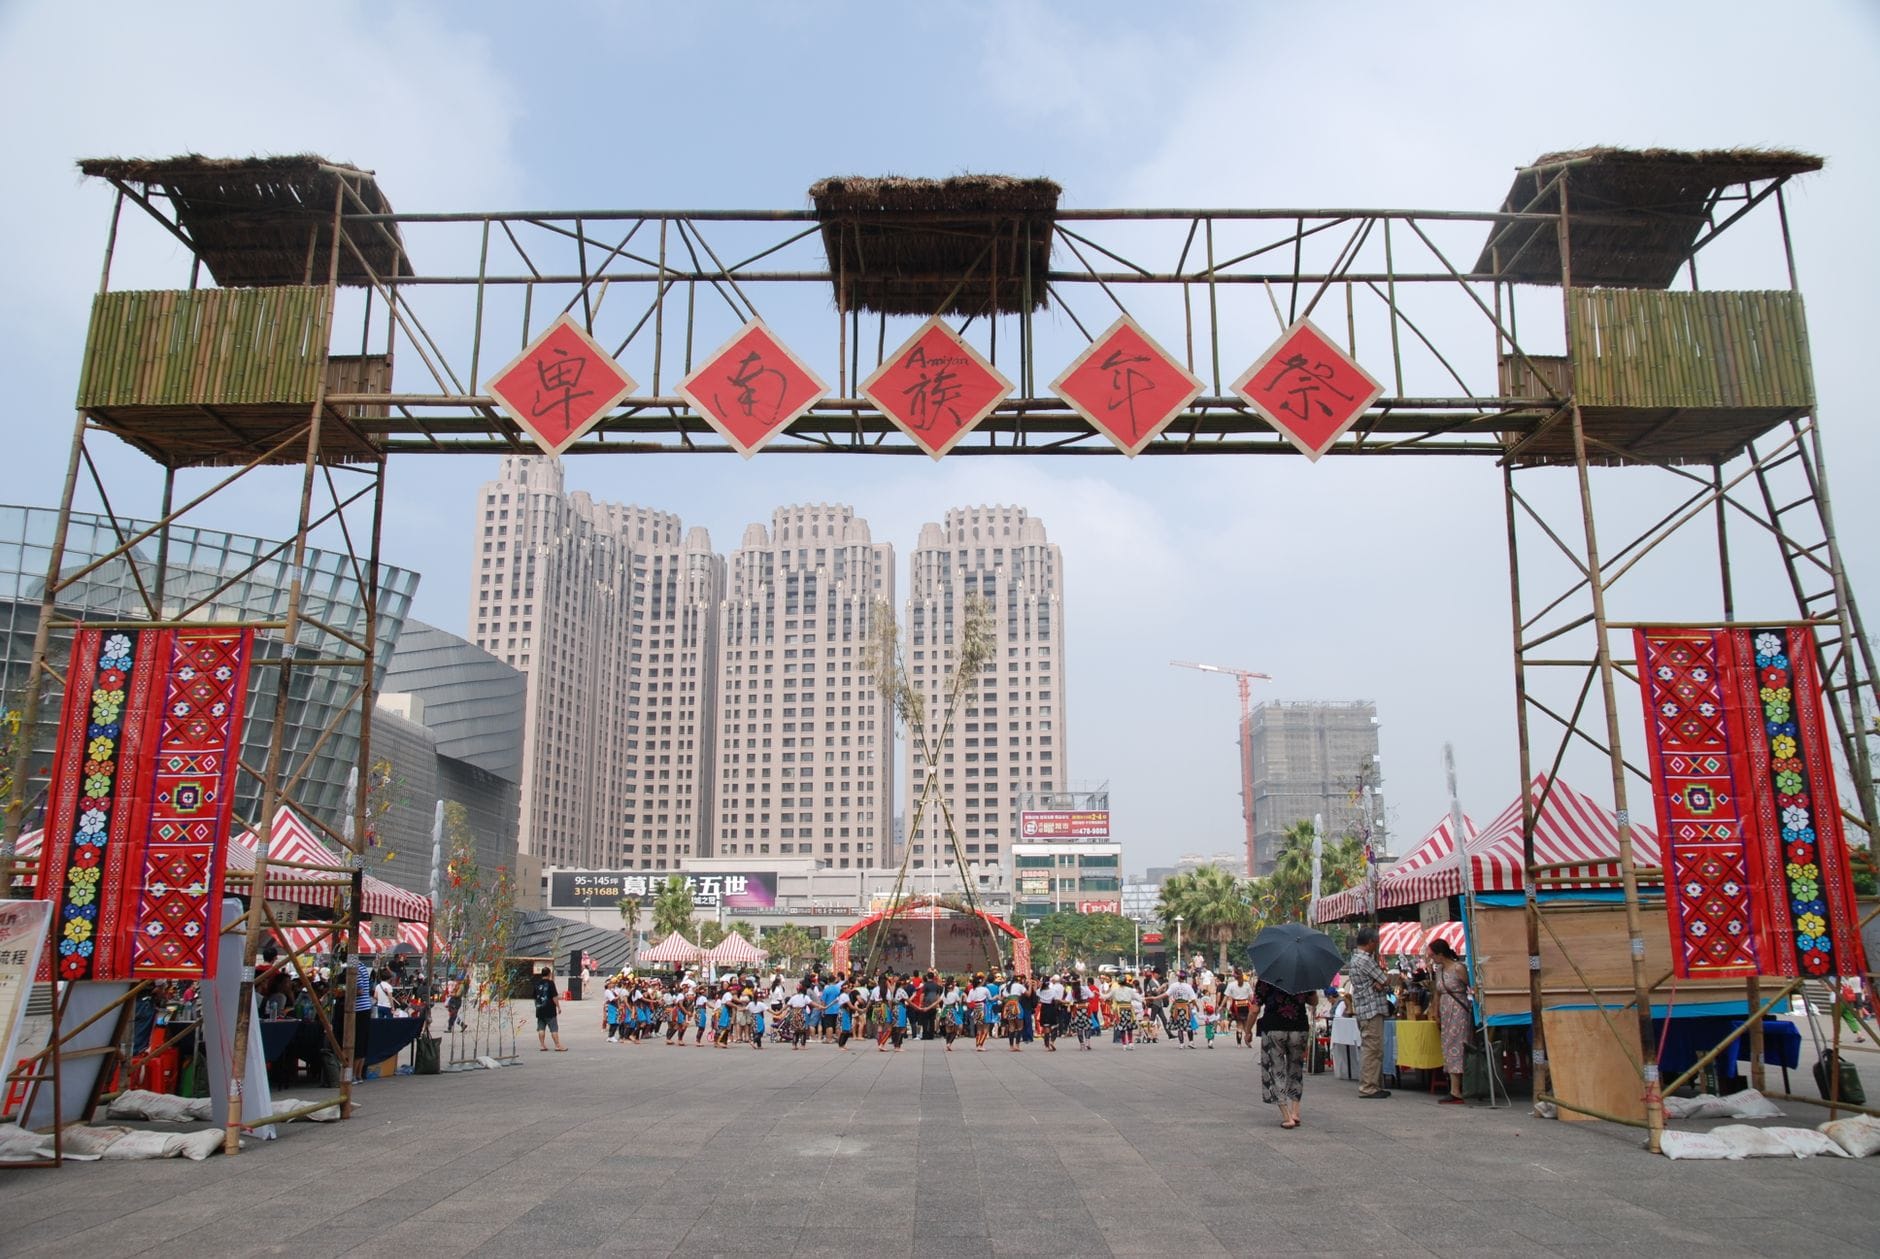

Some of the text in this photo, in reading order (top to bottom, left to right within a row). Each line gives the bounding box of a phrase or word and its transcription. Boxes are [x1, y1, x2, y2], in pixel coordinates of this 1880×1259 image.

[713, 350, 788, 426] 南
[902, 373, 962, 431] 族
[1264, 353, 1354, 421] 祭
[574, 887, 619, 896] 3151688
